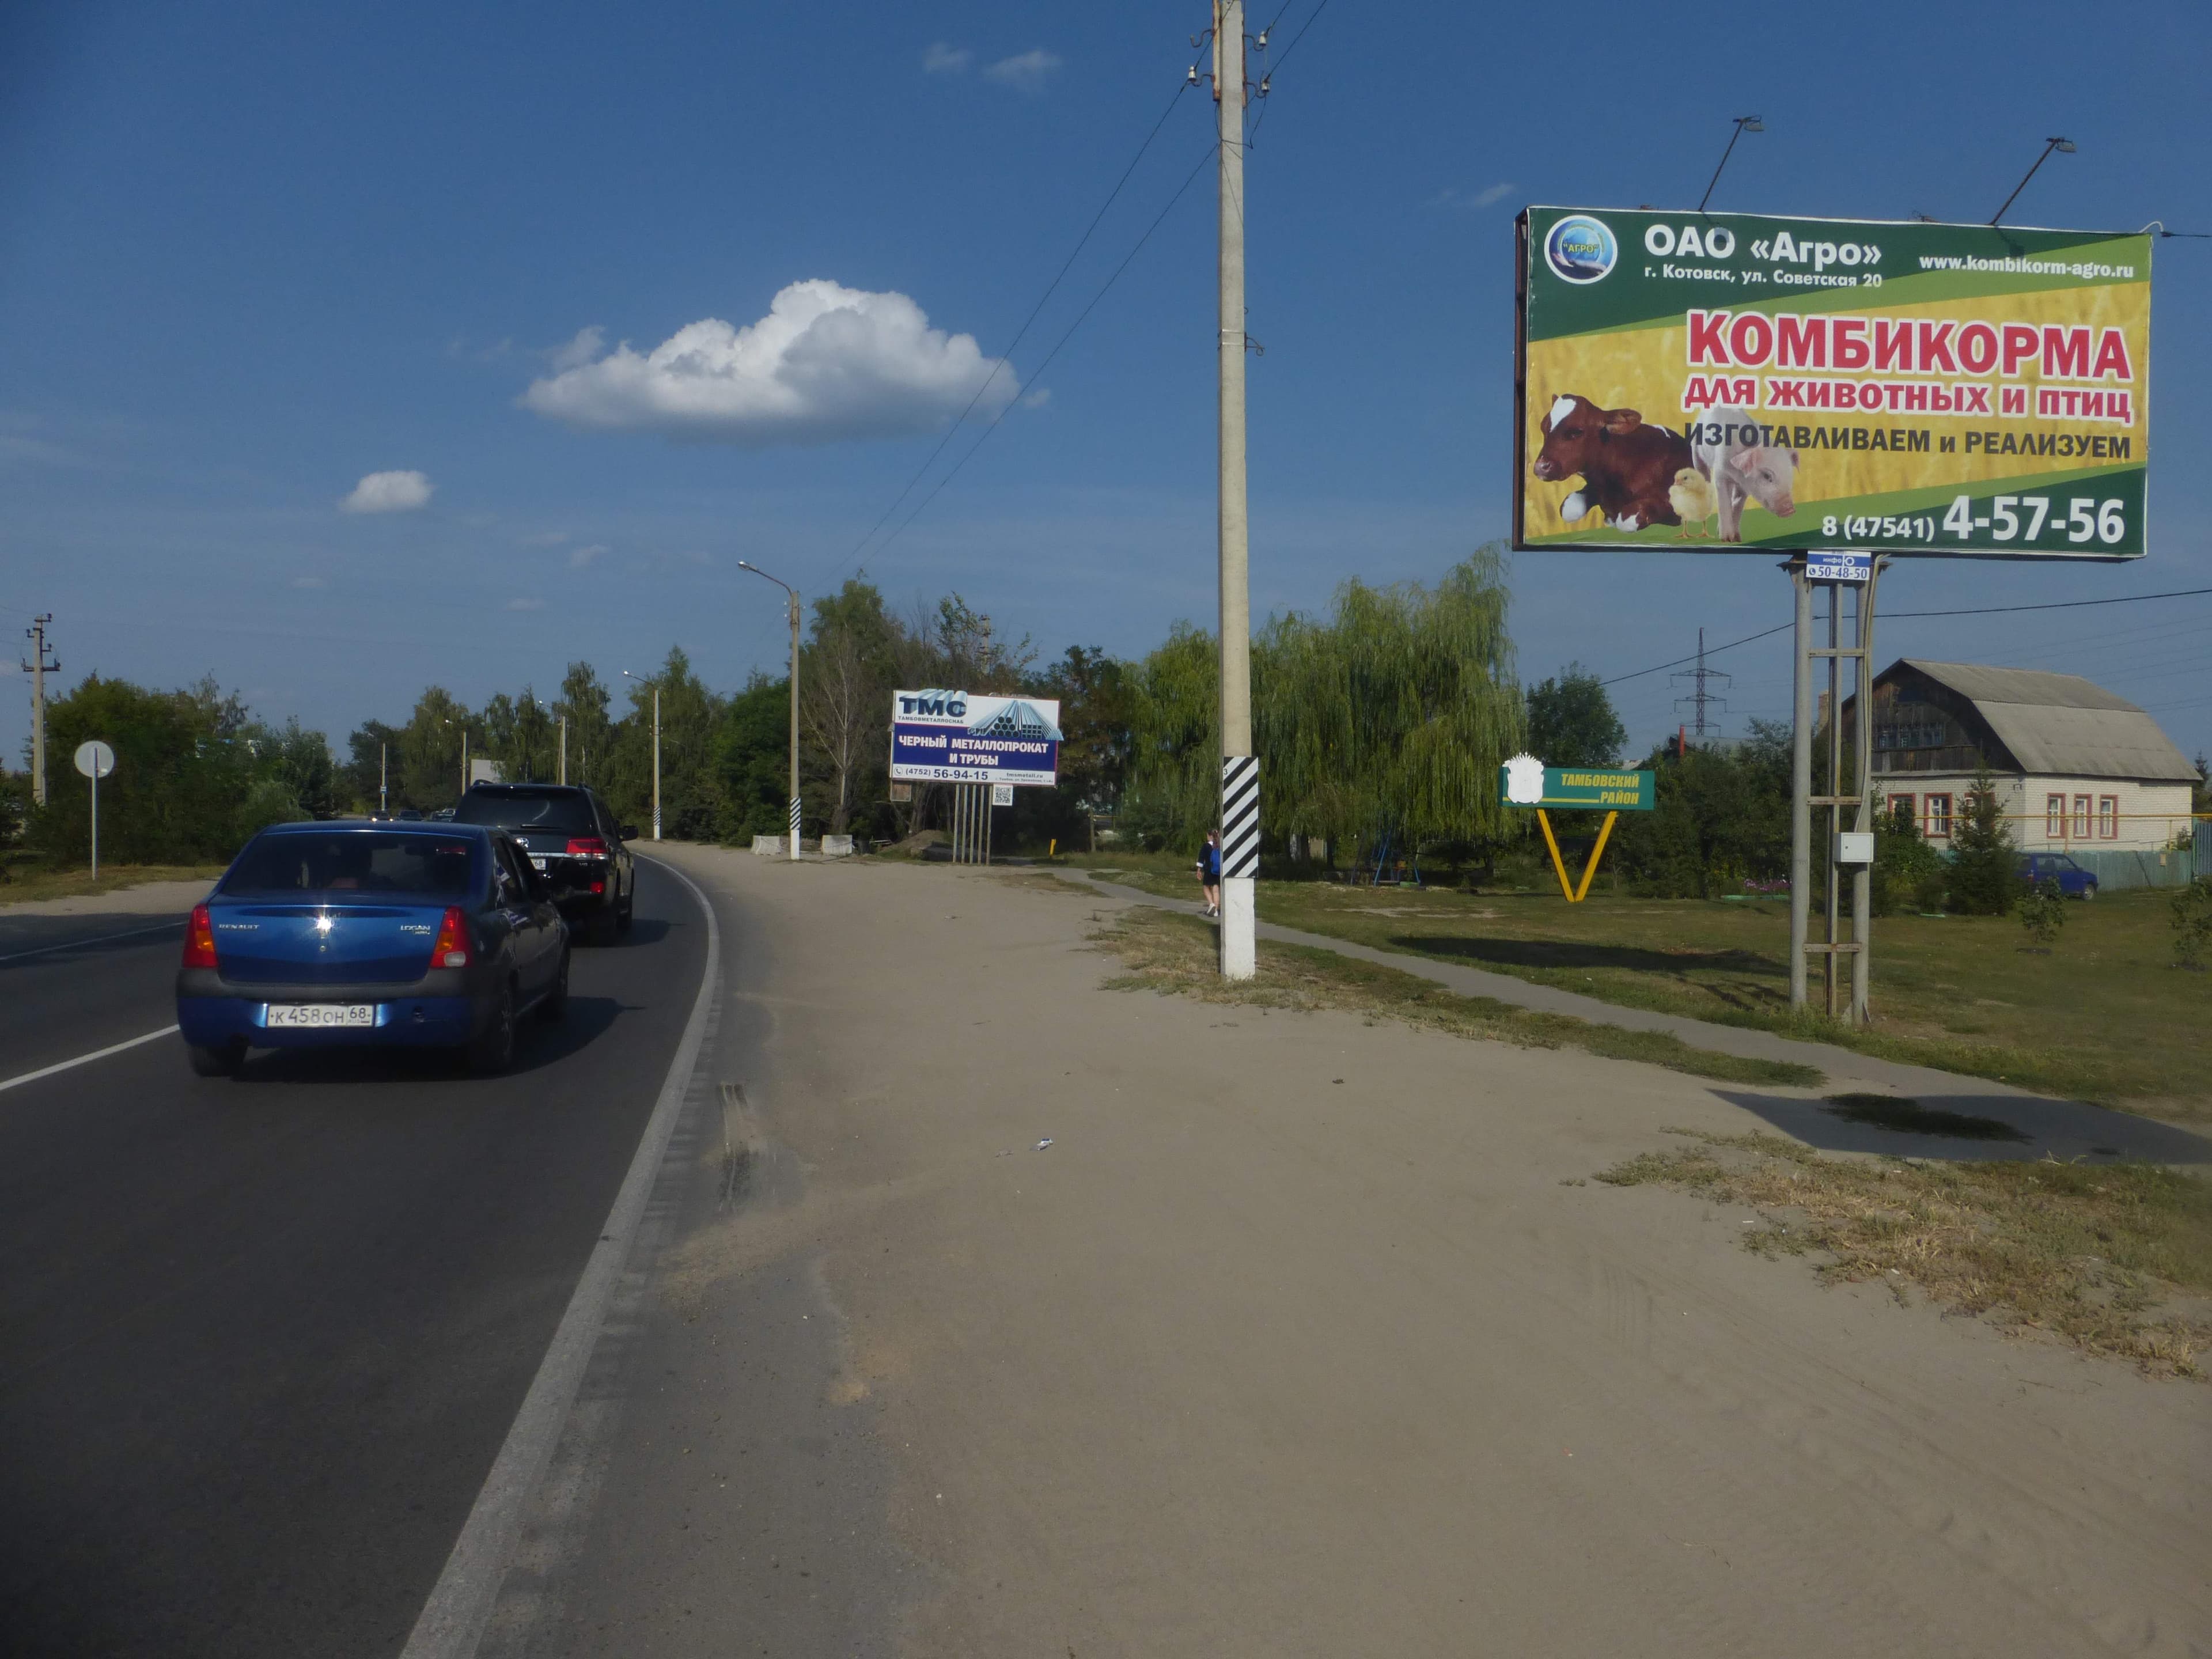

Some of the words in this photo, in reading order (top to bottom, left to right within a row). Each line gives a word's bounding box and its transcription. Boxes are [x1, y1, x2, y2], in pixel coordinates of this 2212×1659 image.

[1645, 224, 1736, 259] ОАО
[1750, 232, 1882, 271] «Агро»
[1645, 266, 1656, 278] г.
[1663, 264, 1736, 283] Котовск,
[1741, 271, 1767, 286] ул.
[1774, 271, 1858, 287] Советская
[1862, 274, 1883, 287] 20
[1919, 255, 2134, 279] www.kombikorm-agro.ru
[1688, 312, 2133, 381] КОМБИКОРМА
[1684, 377, 1756, 410] ДЛЯ
[1768, 380, 1990, 414] ЖИВОТНЫХ
[2038, 389, 2131, 424] ПТИЦ
[1685, 422, 1930, 453] ИЗГОТАВЛИВАЕМ
[1965, 431, 2131, 459] РЕАЛИЗУЕМ
[1821, 516, 1838, 537] 8
[1843, 515, 1936, 543] (47541)
[1942, 495, 2126, 544] 4-57-56
[1817, 566, 1868, 579] 50-48-50
[899, 694, 967, 718] ТМС
[898, 715, 964, 724] ТАМБОВМЕТАЛЛОСНАБ
[899, 735, 947, 748] ЧЕРНЫЙ
[951, 738, 1049, 754] МЕТАЛЛОПРОКАТ
[949, 753, 957, 764] И
[960, 754, 999, 766] ТРУБЫ
[906, 768, 931, 776] (4752)
[934, 768, 988, 781] 56-94-15
[1562, 774, 1639, 787] ТАМБОВСКИЙ
[1600, 790, 1639, 804] РАЙОН
